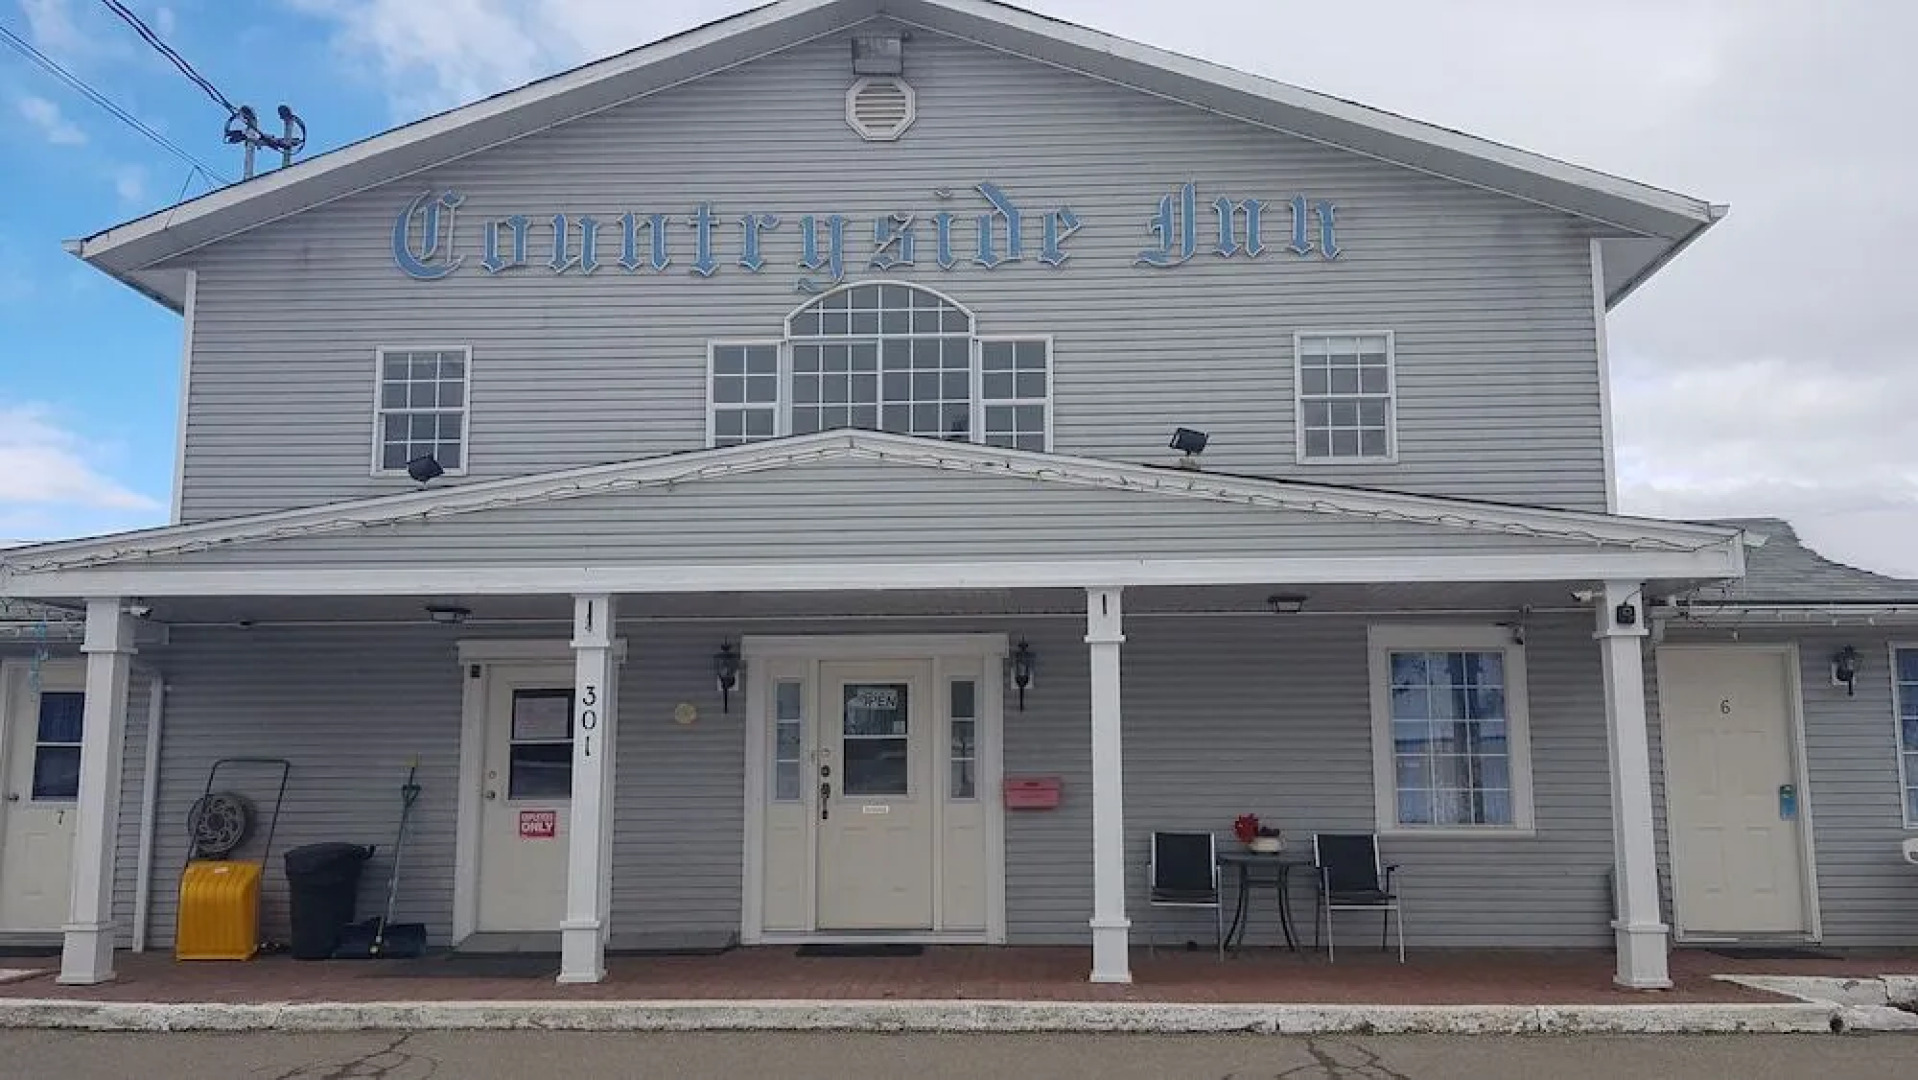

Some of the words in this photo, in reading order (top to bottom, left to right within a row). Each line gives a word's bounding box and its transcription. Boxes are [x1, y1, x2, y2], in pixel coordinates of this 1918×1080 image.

[390, 182, 1083, 292] Countryside
[1133, 181, 1341, 266] Inn
[1720, 699, 1731, 714] 6
[582, 686, 597, 757] 301
[57, 810, 65, 826] 7
[521, 821, 554, 833] ONLY
